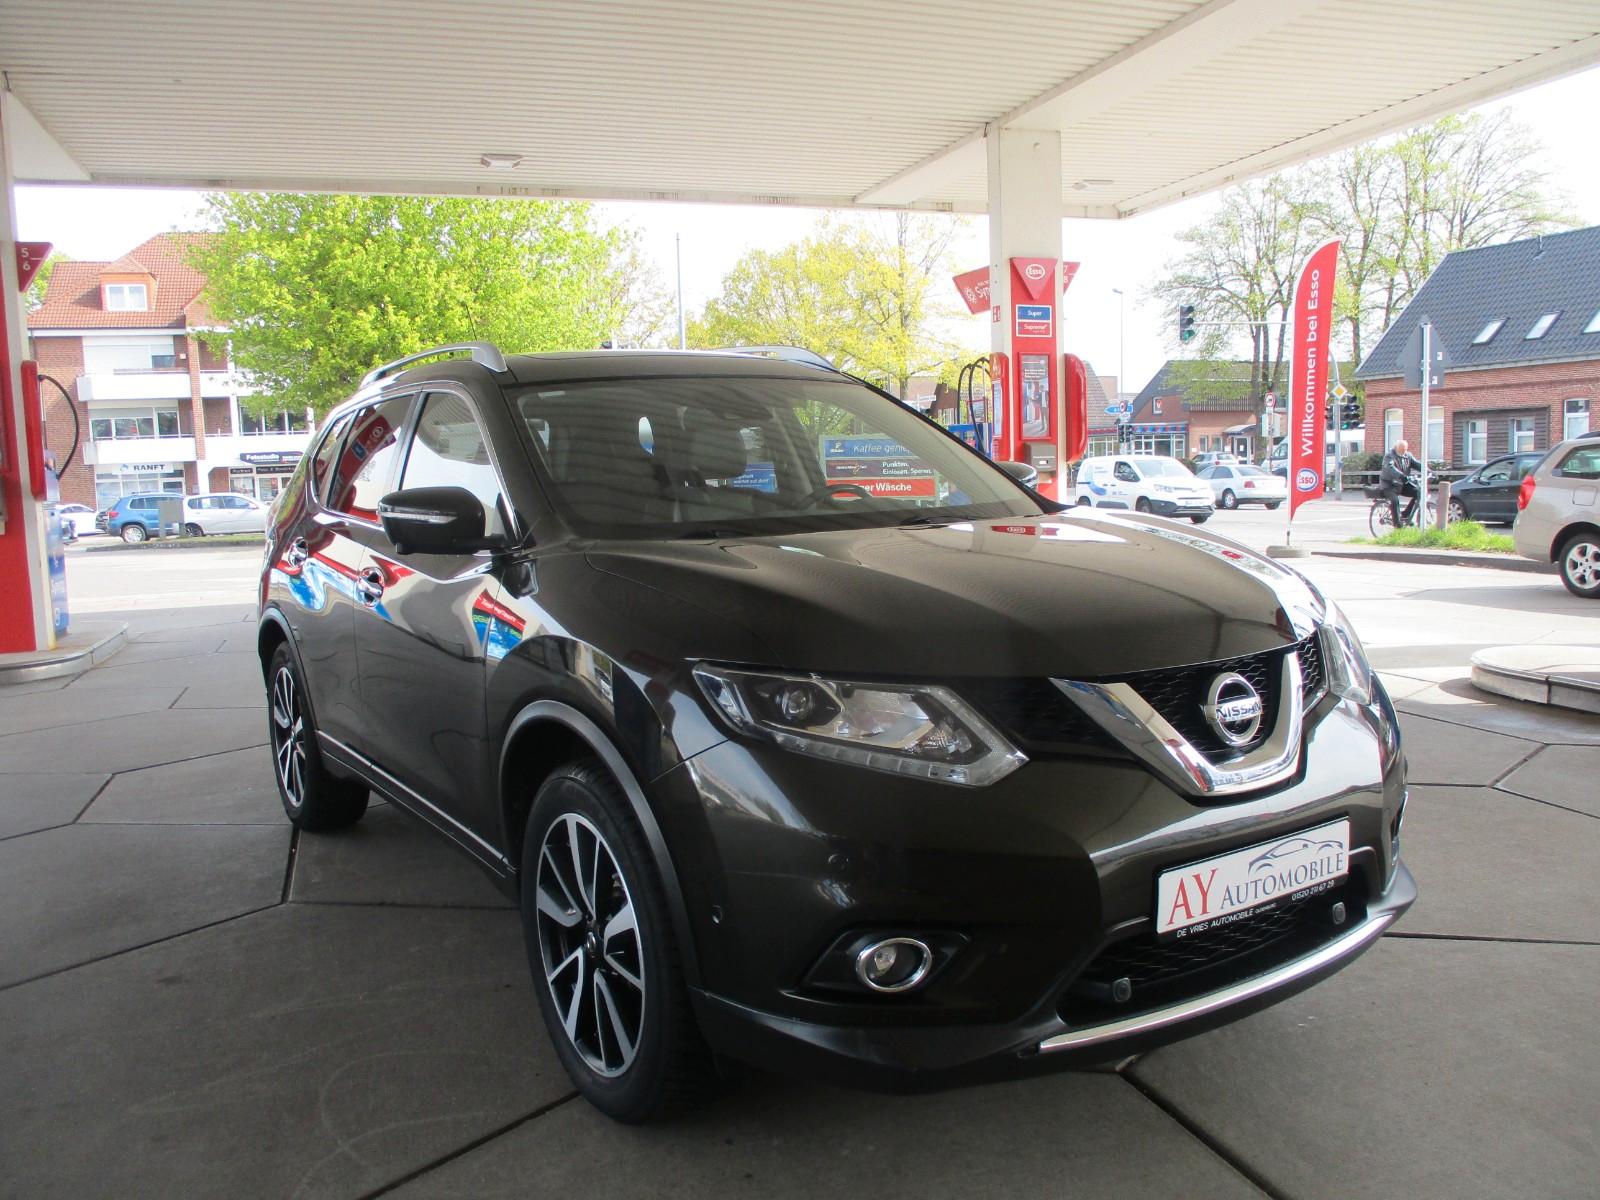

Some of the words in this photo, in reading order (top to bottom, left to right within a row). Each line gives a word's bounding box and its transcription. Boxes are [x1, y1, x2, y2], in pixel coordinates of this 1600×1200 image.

[21, 247, 29, 258] 5
[23, 261, 31, 271] 6
[1028, 267, 1043, 275] Esso
[1307, 269, 1320, 311] Esso
[1027, 310, 1042, 318] Super
[1306, 315, 1318, 342] bei
[1301, 347, 1317, 457] Willkommen
[853, 444, 881, 453] Kaffee
[875, 482, 912, 492] Wäsche
[1215, 701, 1262, 719] NISSAN
[1166, 867, 1218, 926] AY
[1220, 852, 1344, 910] AUTOMOBILE
[1176, 928, 1187, 938] DE
[1189, 922, 1209, 934] VRIES
[1210, 908, 1254, 928] AUTOMOBILE
